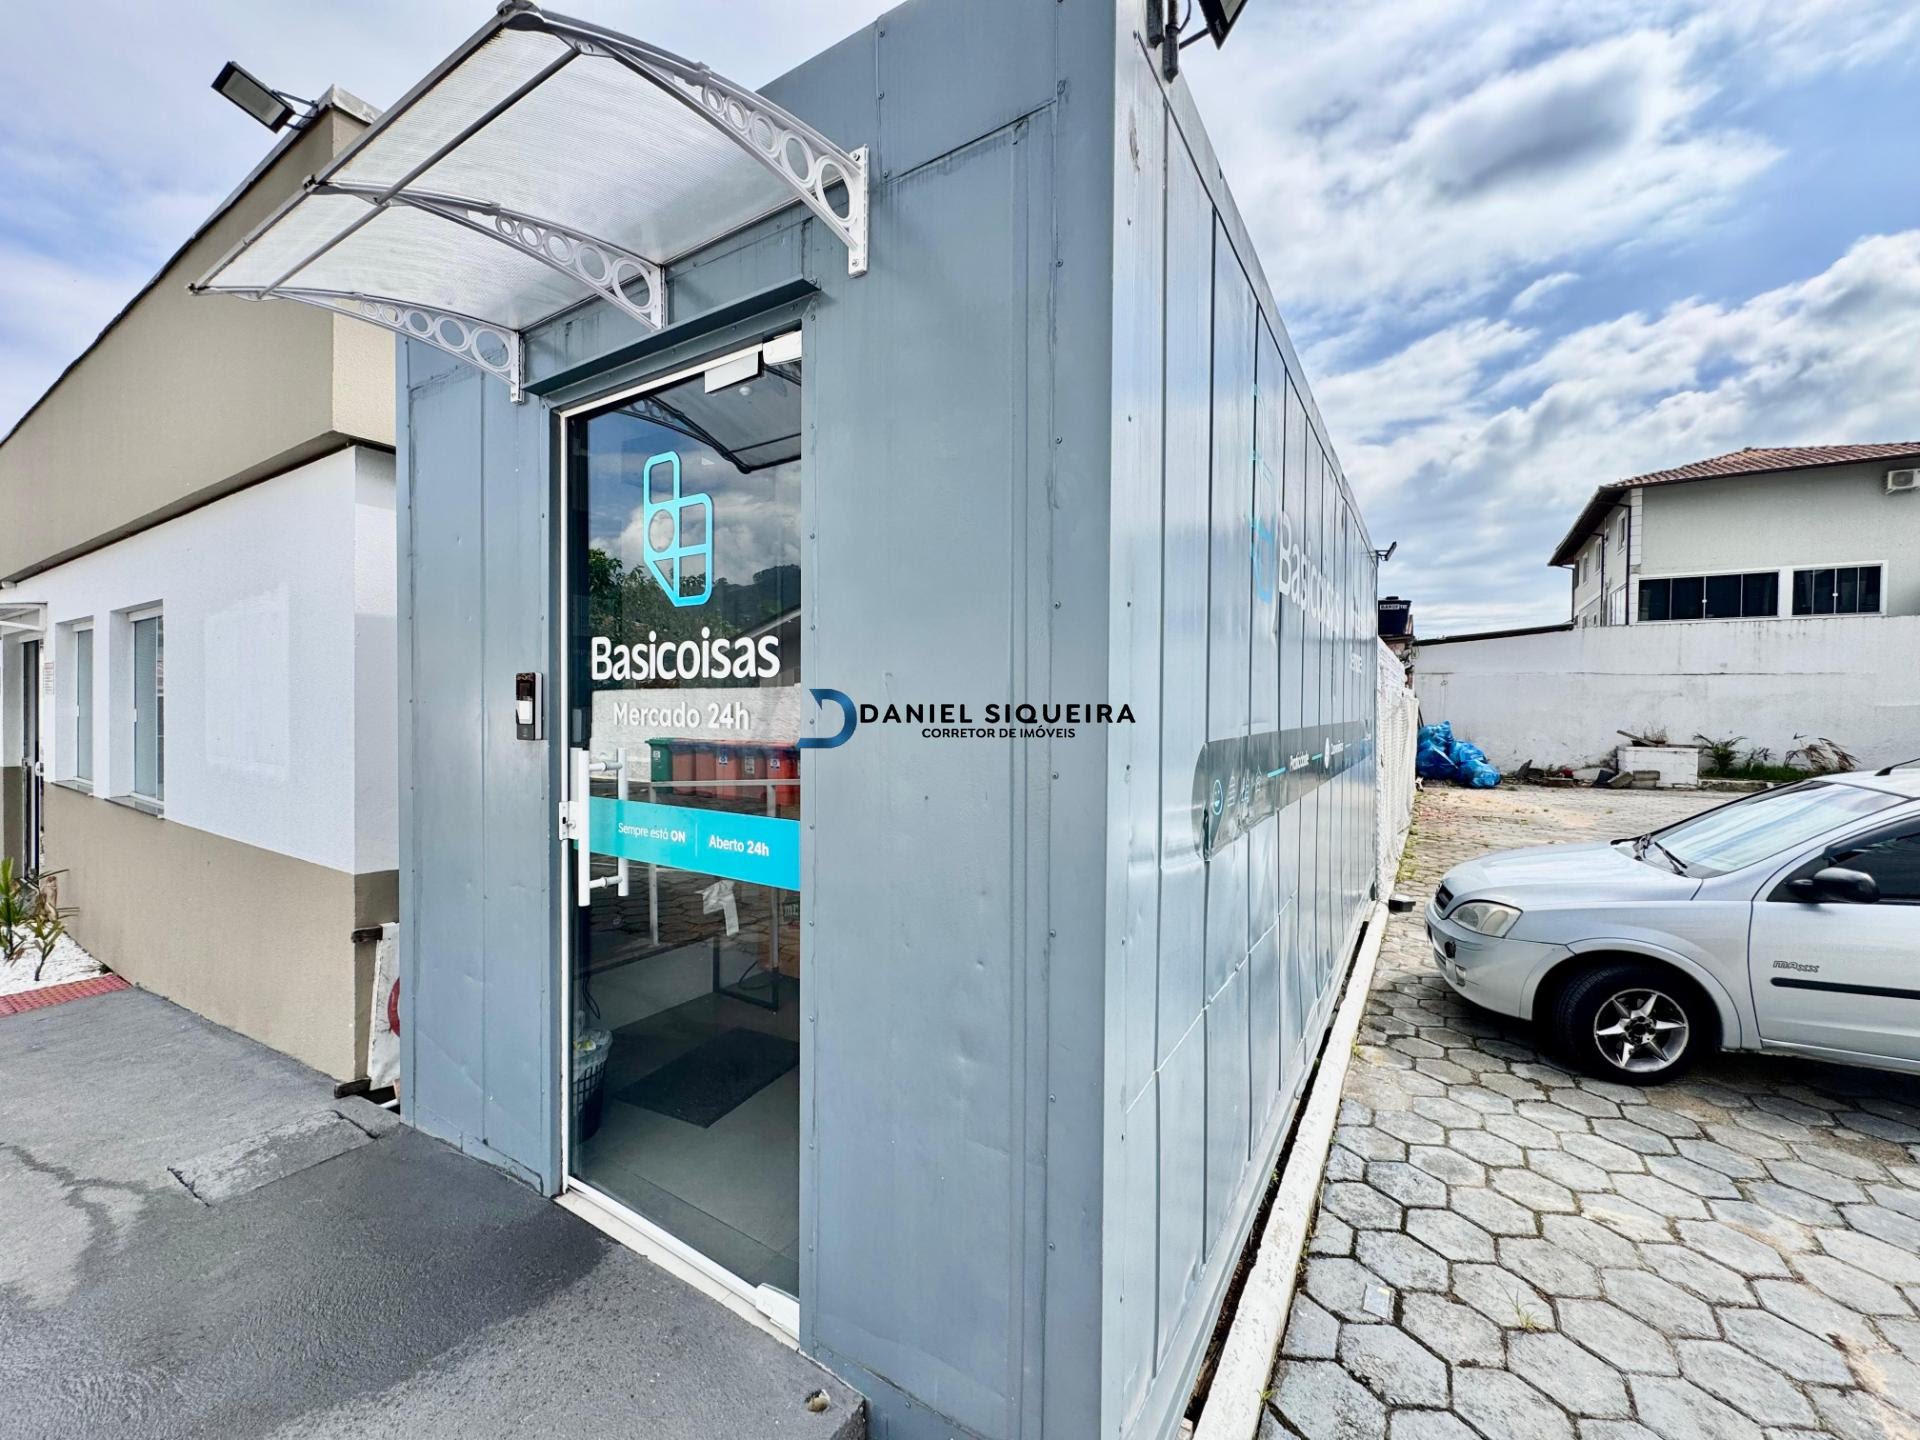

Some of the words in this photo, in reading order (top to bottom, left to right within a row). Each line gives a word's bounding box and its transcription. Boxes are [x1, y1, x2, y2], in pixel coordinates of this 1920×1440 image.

[591, 626, 781, 681] Basicoisas
[613, 702, 701, 729] Mercado
[708, 701, 751, 730] 24h
[618, 822, 649, 838] Sempre
[650, 827, 669, 840] está
[670, 830, 686, 844] ON
[708, 835, 745, 853] Aberto
[746, 840, 770, 857] 24h
